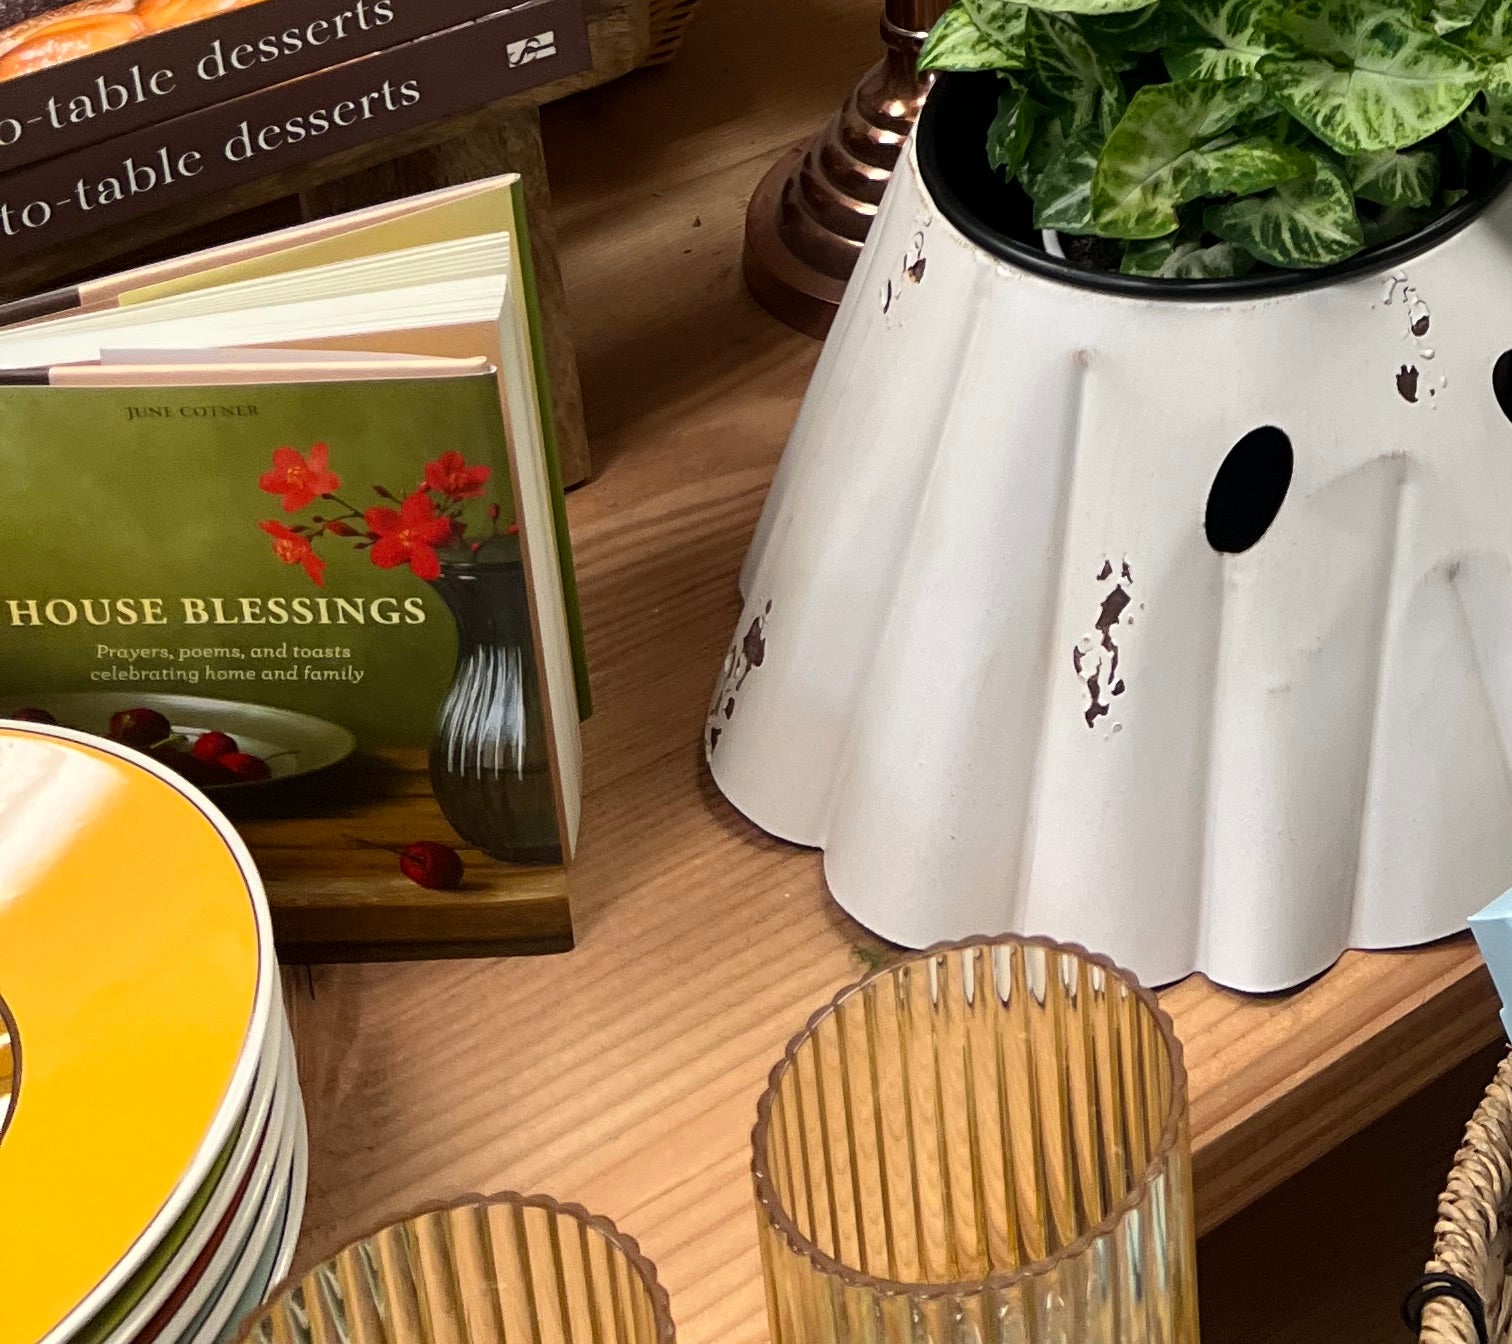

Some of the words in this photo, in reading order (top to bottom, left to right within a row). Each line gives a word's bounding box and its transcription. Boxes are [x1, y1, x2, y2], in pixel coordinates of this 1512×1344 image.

[222, 78, 423, 164] desserts
[126, 404, 173, 421] JUNE
[178, 403, 260, 418] COTNER
[5, 598, 169, 628] HOUSE
[183, 596, 427, 626] BLESSINGS
[96, 643, 175, 663] Prayers,
[178, 645, 247, 663] poems,
[250, 642, 289, 660] and
[293, 644, 352, 660] toasts
[89, 666, 200, 684] celebrating
[204, 665, 256, 682] home
[260, 664, 299, 682] and
[303, 664, 366, 685] family
